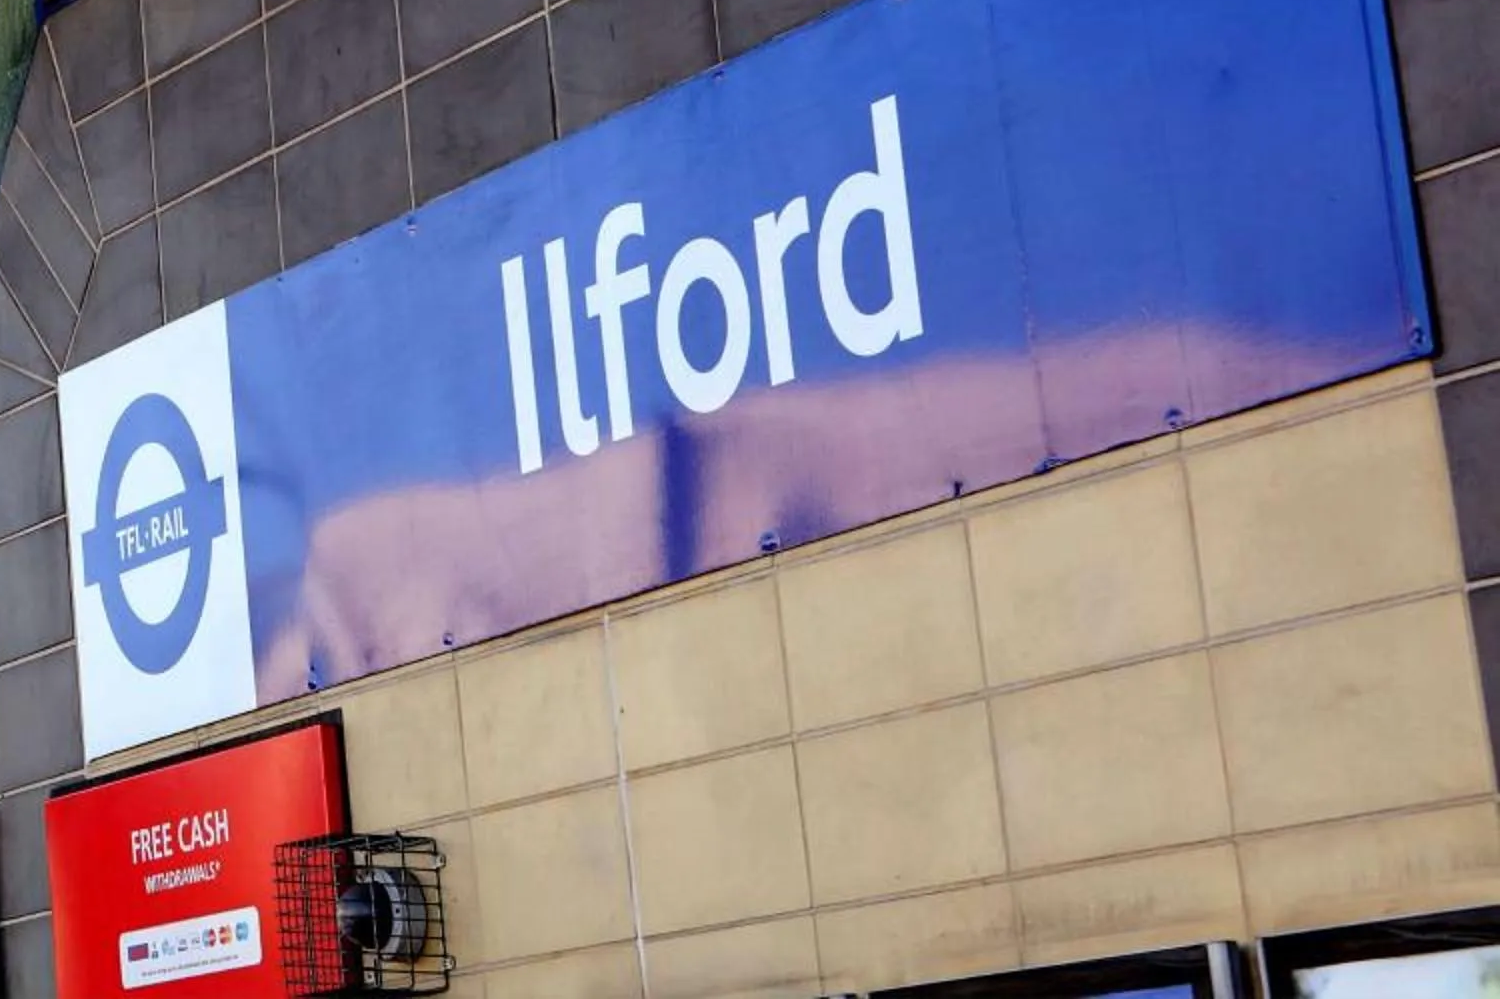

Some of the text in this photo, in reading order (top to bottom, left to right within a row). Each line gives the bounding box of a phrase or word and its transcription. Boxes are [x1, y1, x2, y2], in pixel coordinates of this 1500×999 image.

[501, 94, 924, 475] Ilford
[131, 809, 230, 864] FREE CASH
